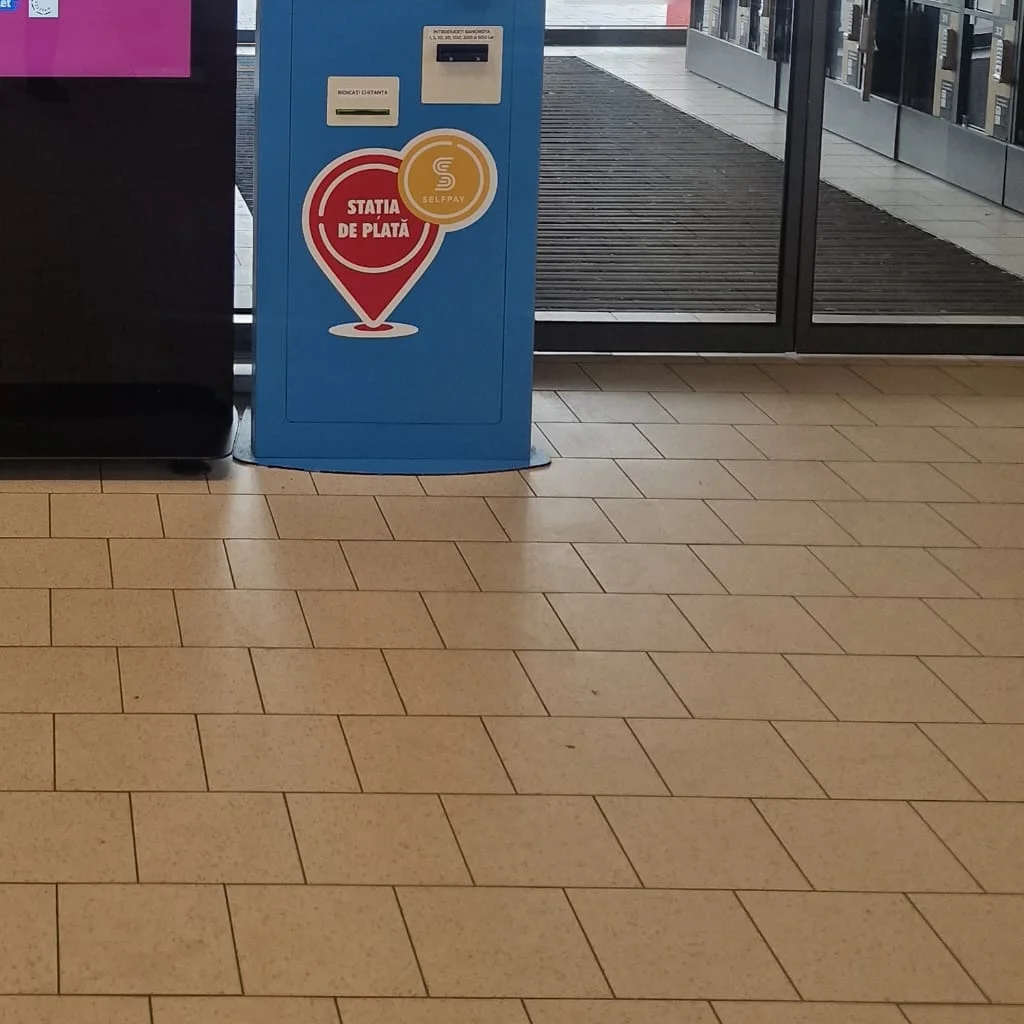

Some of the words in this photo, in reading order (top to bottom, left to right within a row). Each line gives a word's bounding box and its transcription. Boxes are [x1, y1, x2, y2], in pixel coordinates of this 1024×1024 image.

[347, 198, 401, 220] STAȚIA
[422, 195, 466, 204] SELFPAY
[337, 222, 358, 238] DE
[361, 219, 410, 238] PLATĂ
